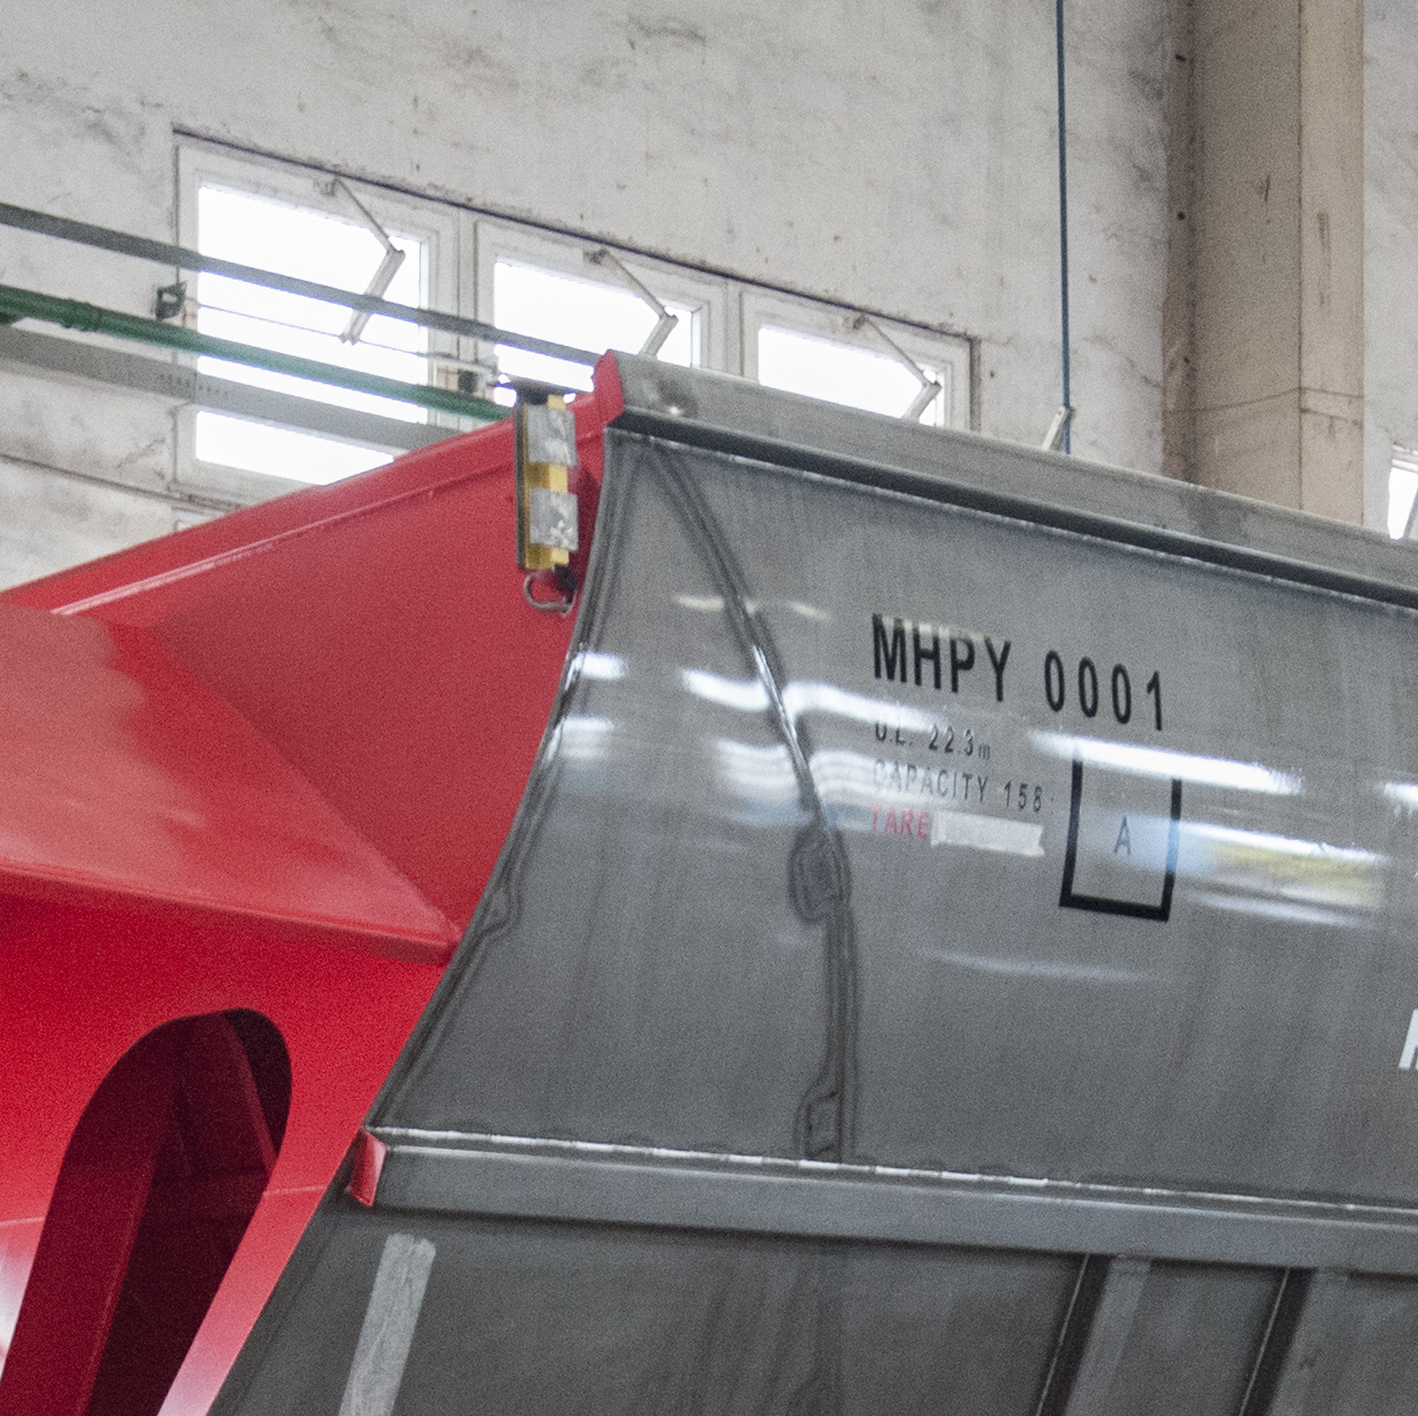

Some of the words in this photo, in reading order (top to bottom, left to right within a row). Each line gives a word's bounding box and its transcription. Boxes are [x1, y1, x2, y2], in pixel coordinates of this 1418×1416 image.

[872, 613, 1011, 702] MHPY
[1044, 650, 1164, 731] 0001
[873, 759, 989, 802] CAPACITY
[871, 802, 930, 840] TARE
[1113, 815, 1132, 857] A
